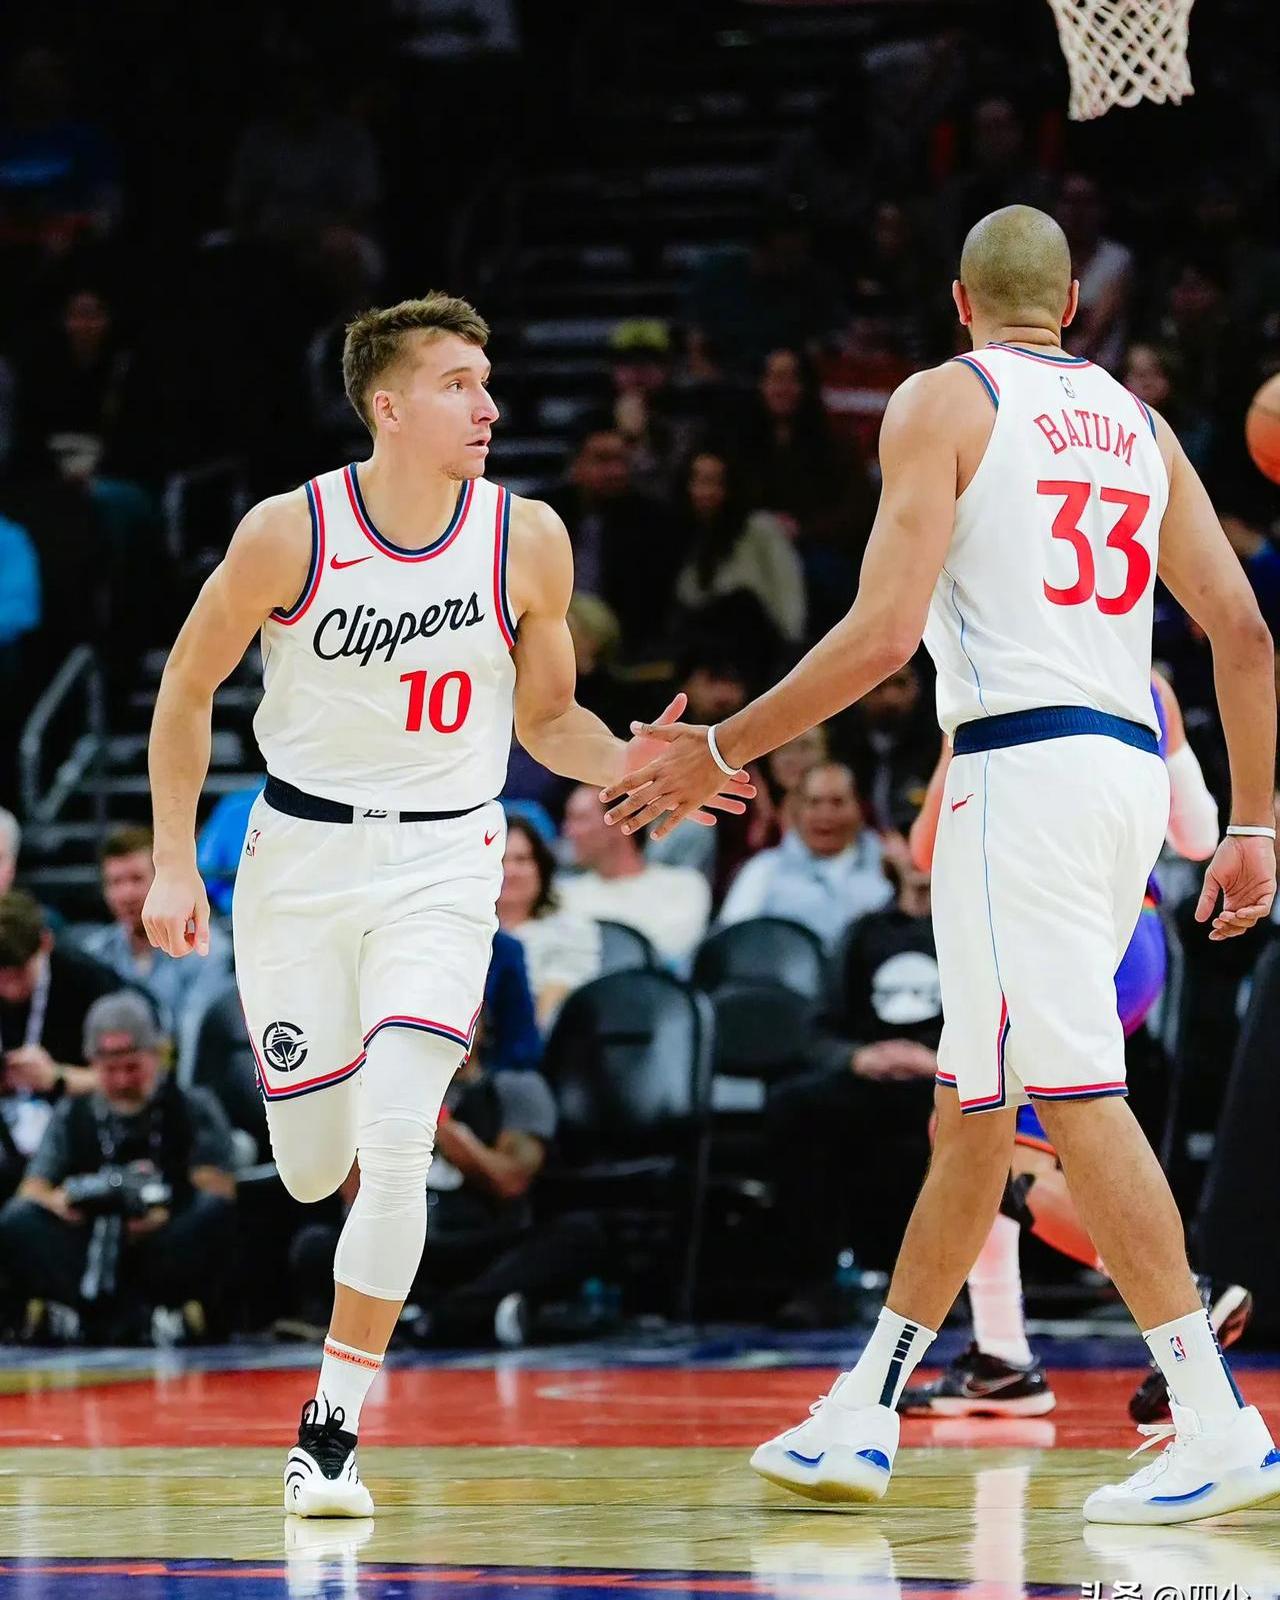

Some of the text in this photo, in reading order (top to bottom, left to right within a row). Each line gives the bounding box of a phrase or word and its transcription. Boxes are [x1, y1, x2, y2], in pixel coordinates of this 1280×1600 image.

[1033, 408, 1137, 466] BATUM
[1037, 479, 1151, 615] 33
[313, 592, 486, 667] Clippers
[400, 670, 472, 733] 10
